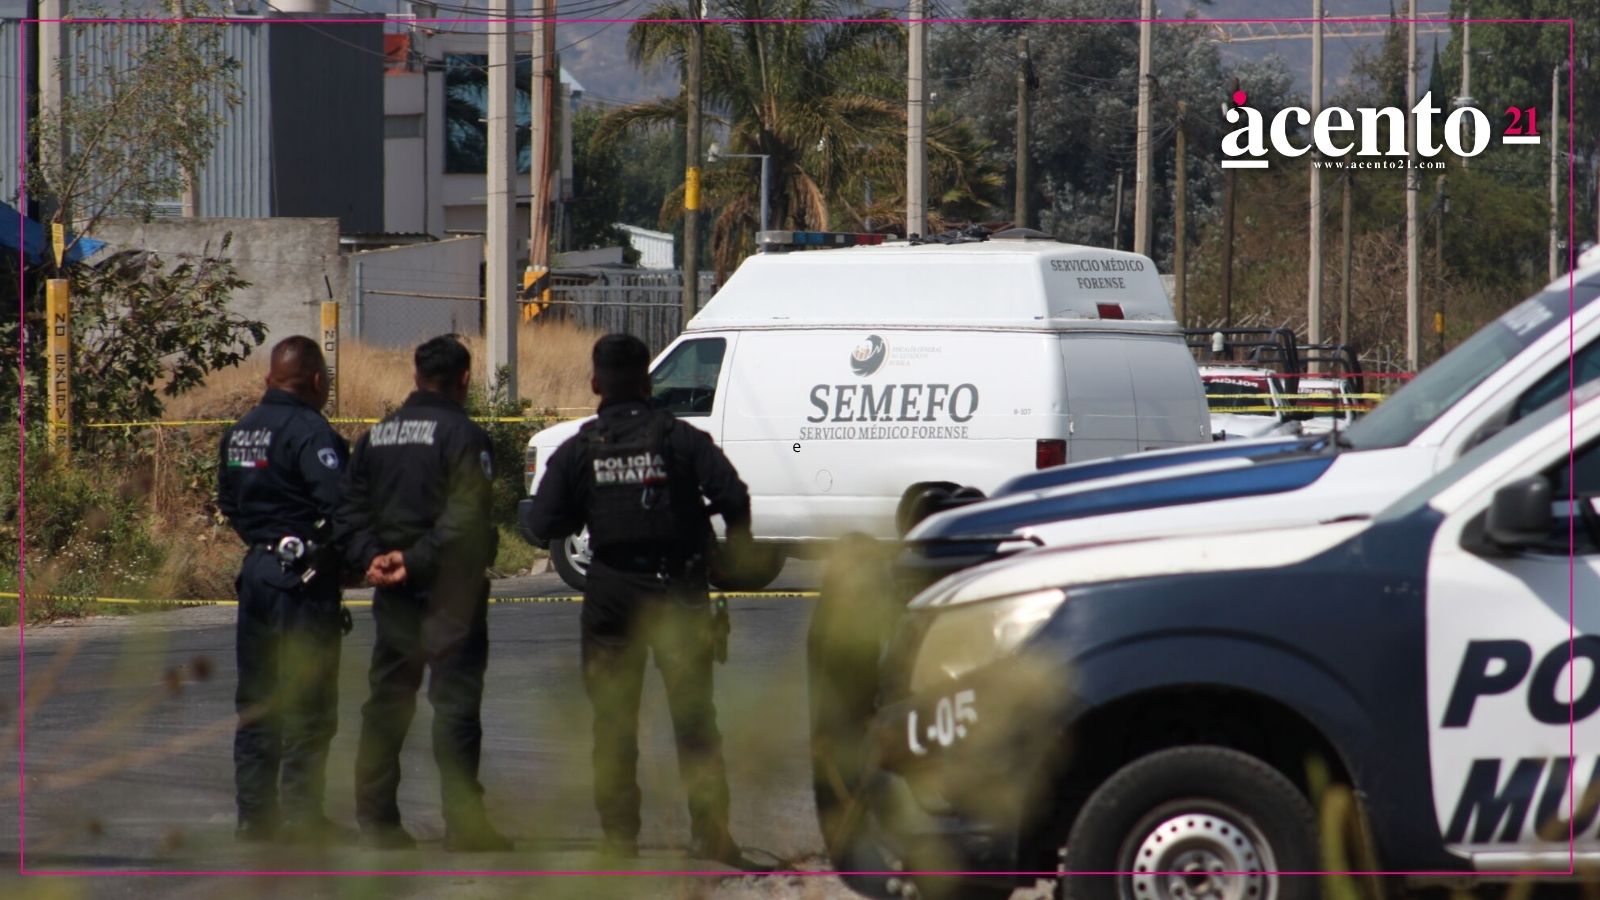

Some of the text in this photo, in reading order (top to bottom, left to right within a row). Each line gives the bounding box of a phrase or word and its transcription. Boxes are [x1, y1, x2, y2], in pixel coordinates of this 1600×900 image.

[1050, 257, 1145, 272] SERVICIO MÉDICO
[1076, 277, 1126, 289] FORENSE
[807, 383, 979, 423] SEMEFO
[398, 420, 437, 446] ESTATAL
[799, 424, 969, 441] SERVICIO MÉDICO FORENSE
[1440, 633, 1600, 728] PO
